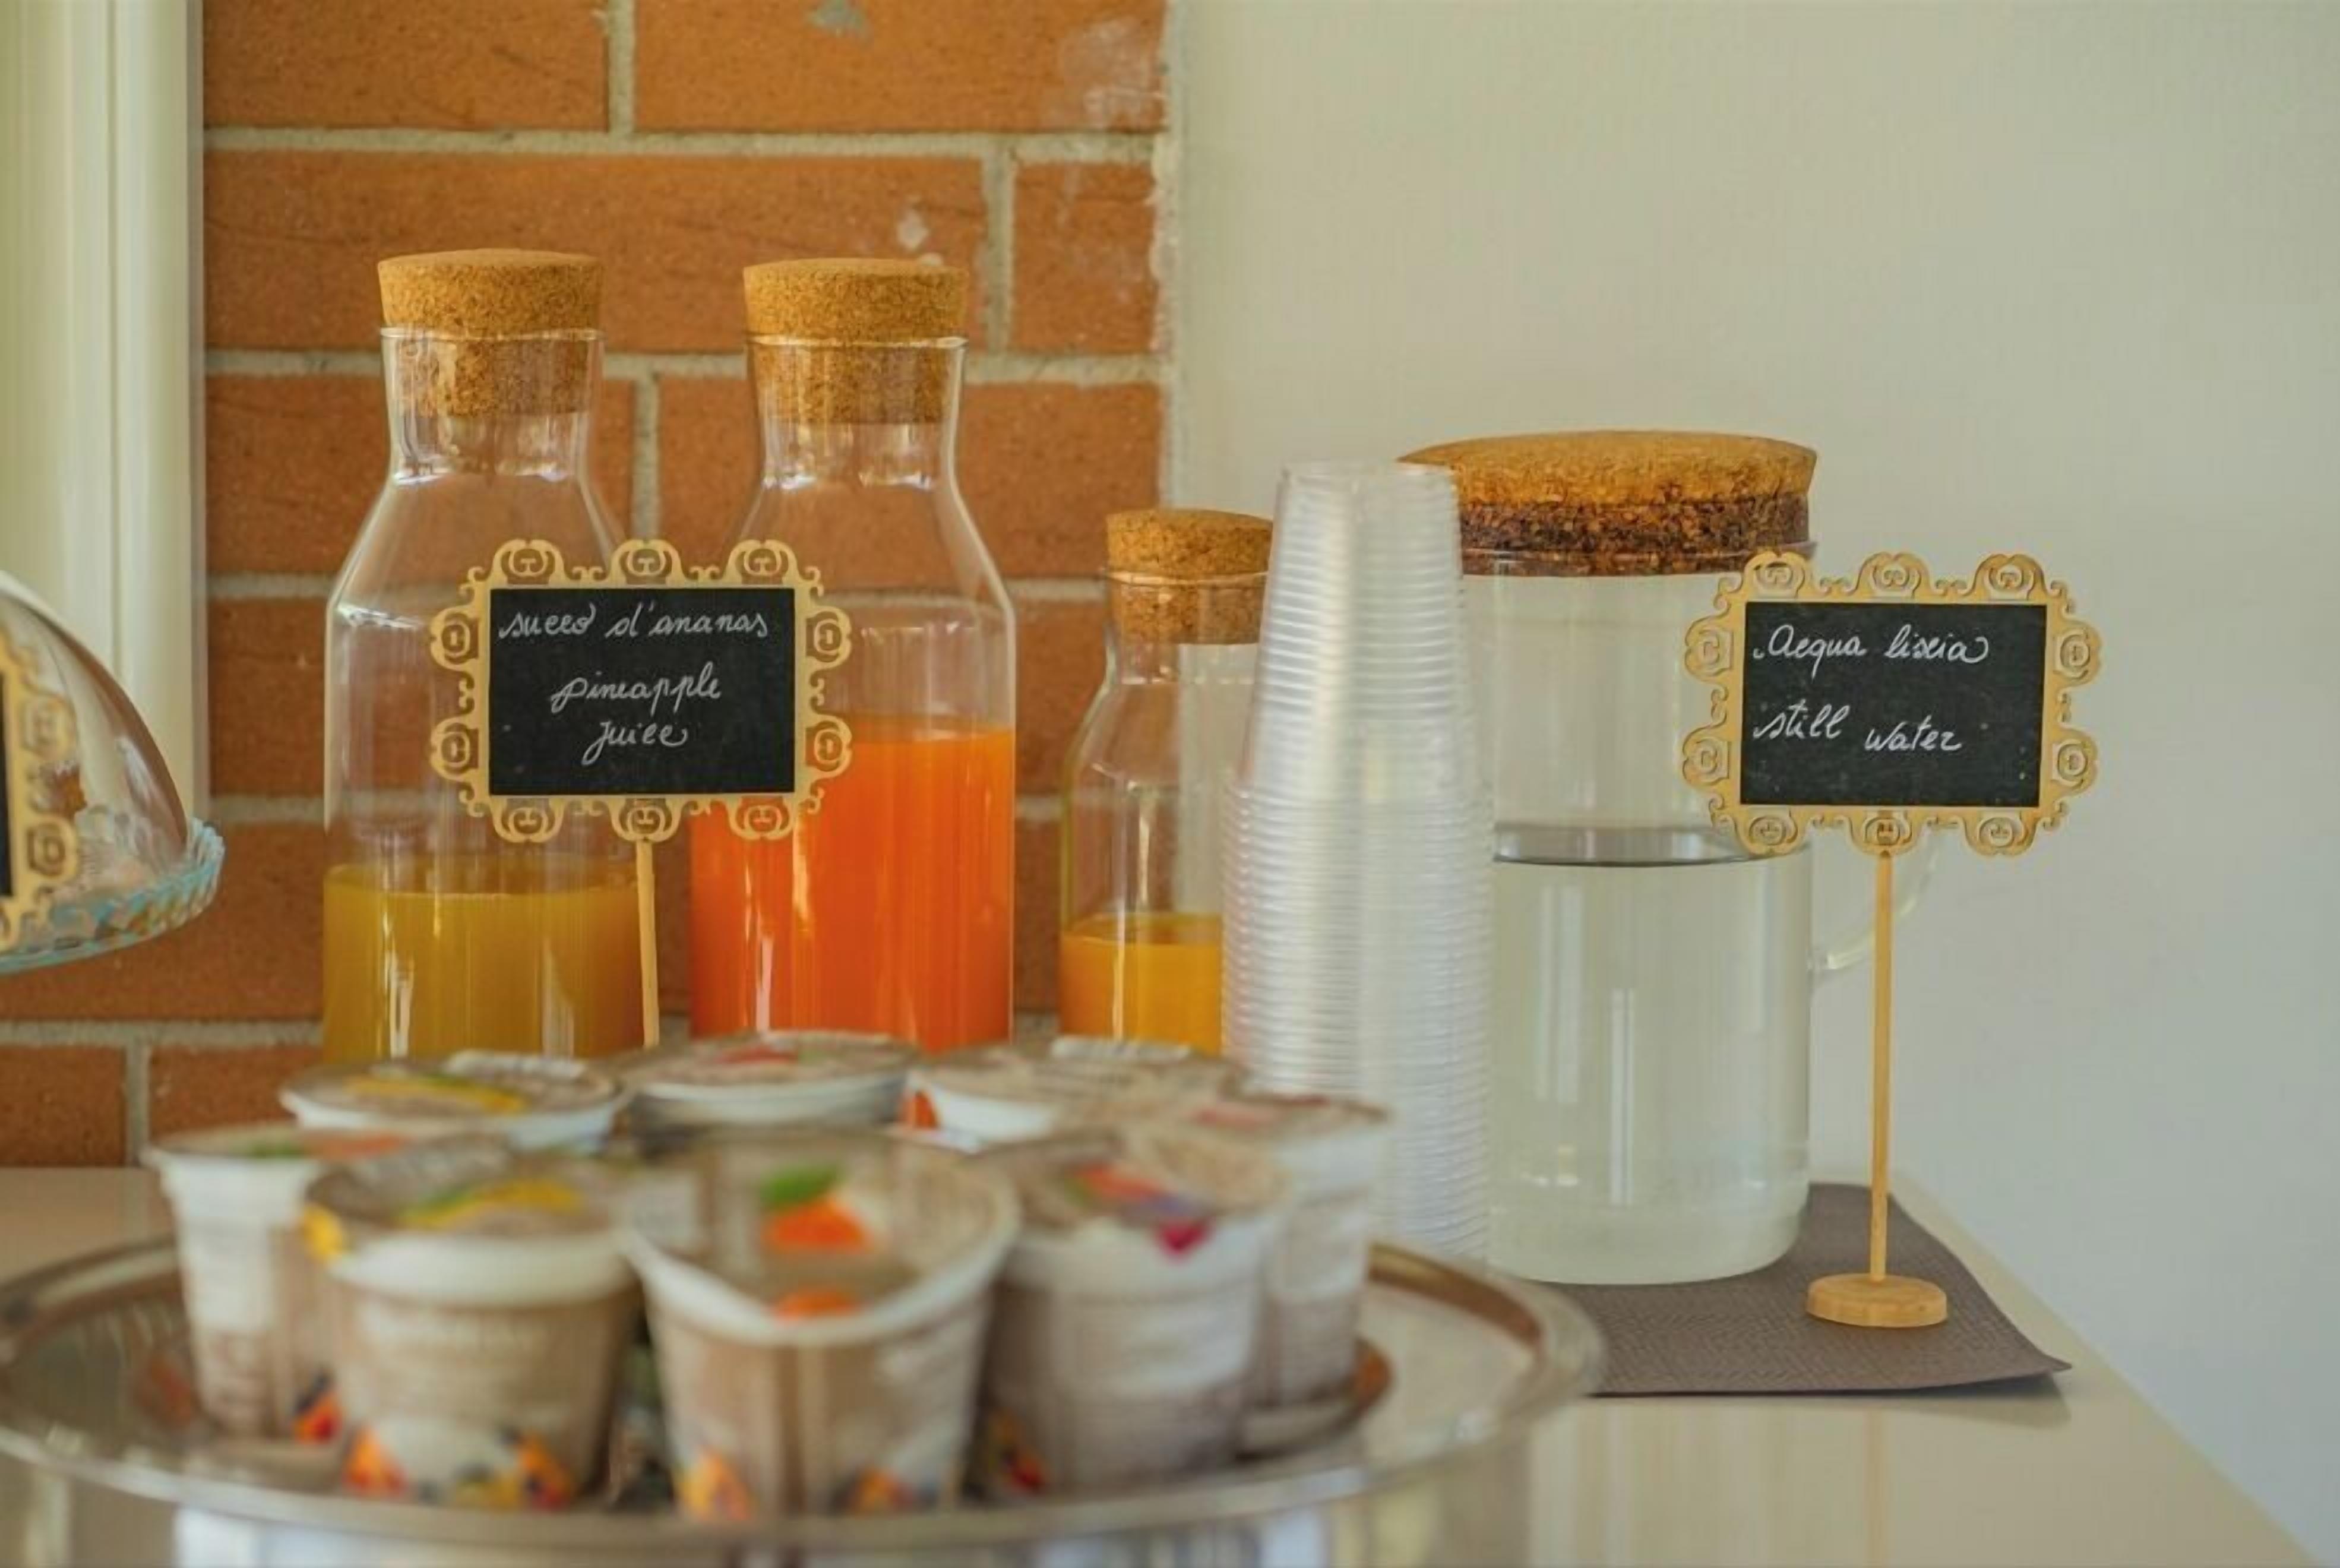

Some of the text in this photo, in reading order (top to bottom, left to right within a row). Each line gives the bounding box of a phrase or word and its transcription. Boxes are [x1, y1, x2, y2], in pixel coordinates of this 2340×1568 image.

[604, 601, 769, 638] d'ananas
[1753, 624, 1868, 680] Acqua
[551, 660, 720, 715] pineapple
[581, 720, 689, 767] juice
[1753, 698, 1963, 751] still water
